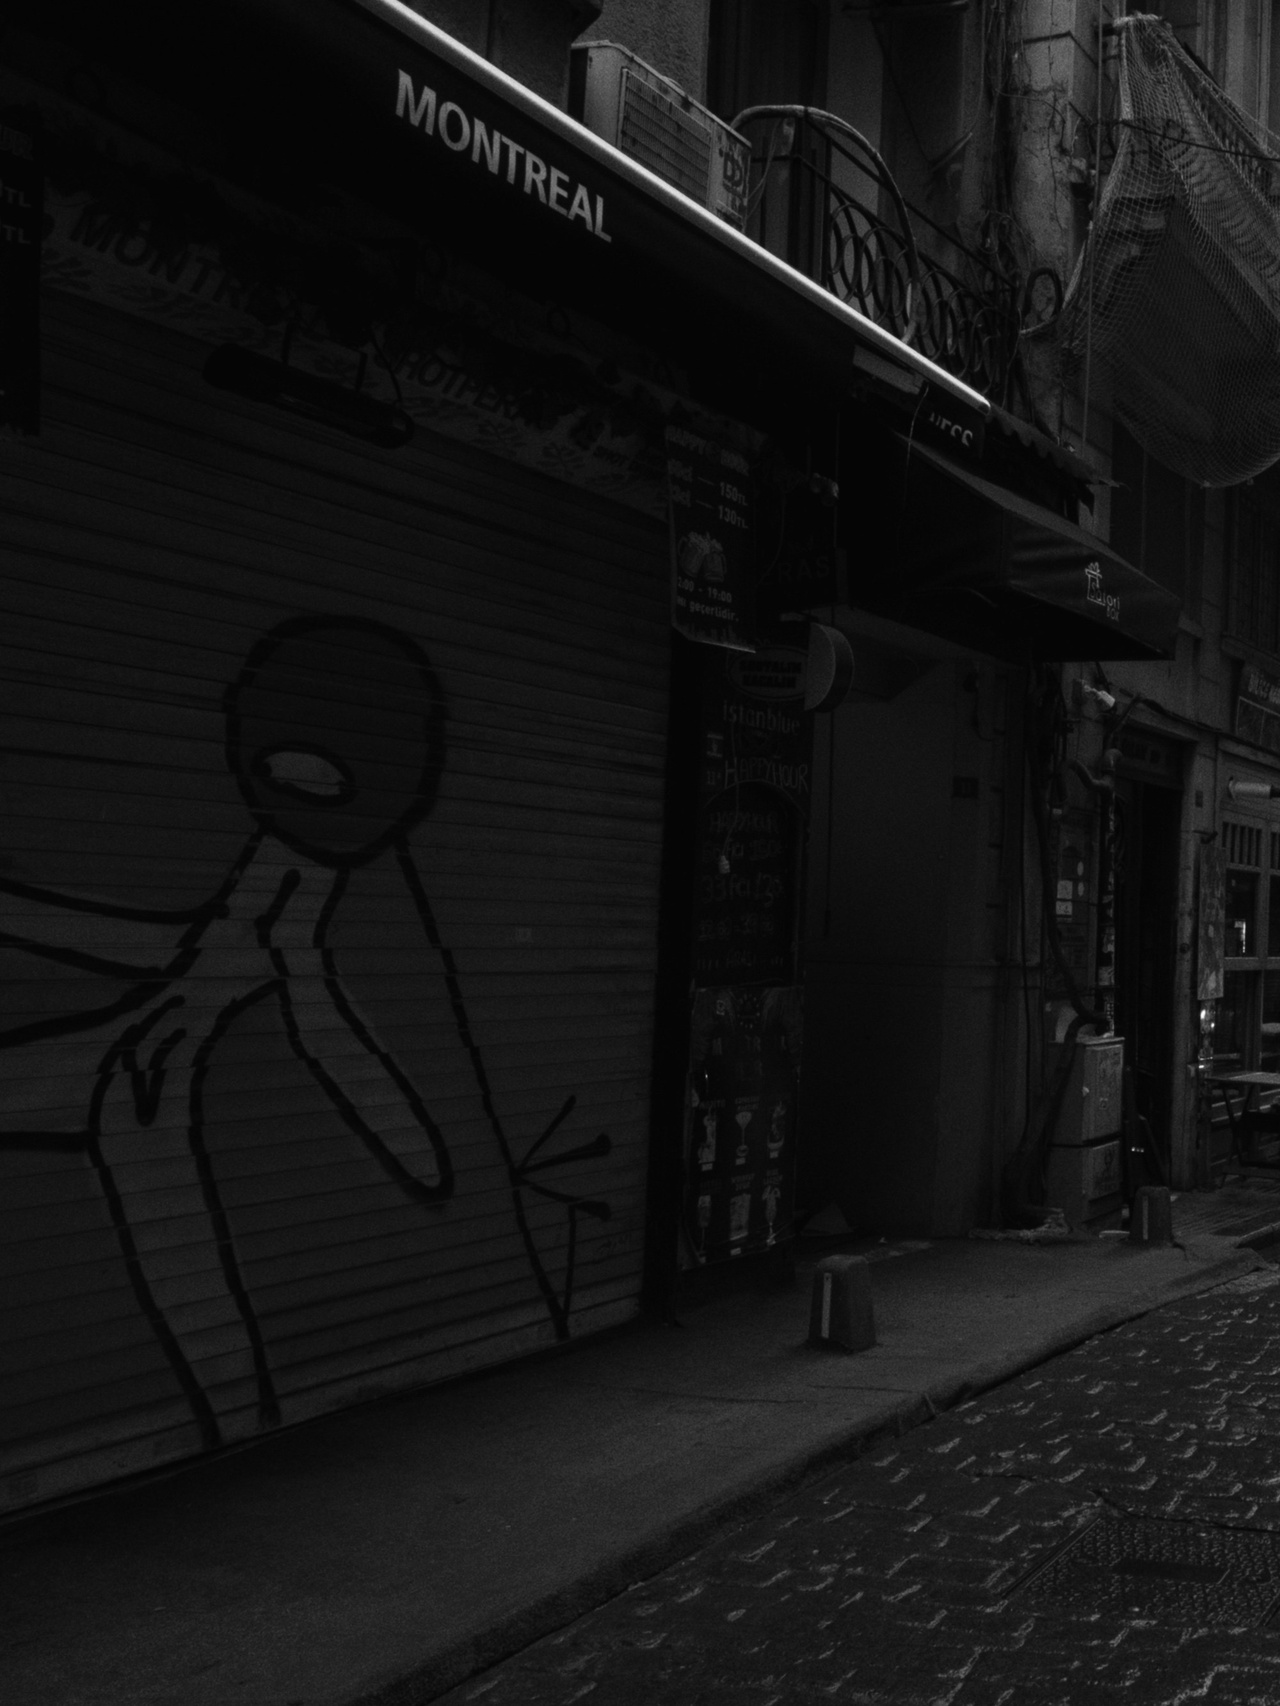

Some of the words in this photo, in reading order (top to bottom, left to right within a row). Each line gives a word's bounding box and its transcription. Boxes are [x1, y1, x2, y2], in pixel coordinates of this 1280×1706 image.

[0, 123, 34, 161] UR
[395, 68, 612, 243] MONTREAL
[0, 217, 31, 244] TL
[718, 505, 749, 530] 130TL
[707, 586, 733, 605] 19:00
